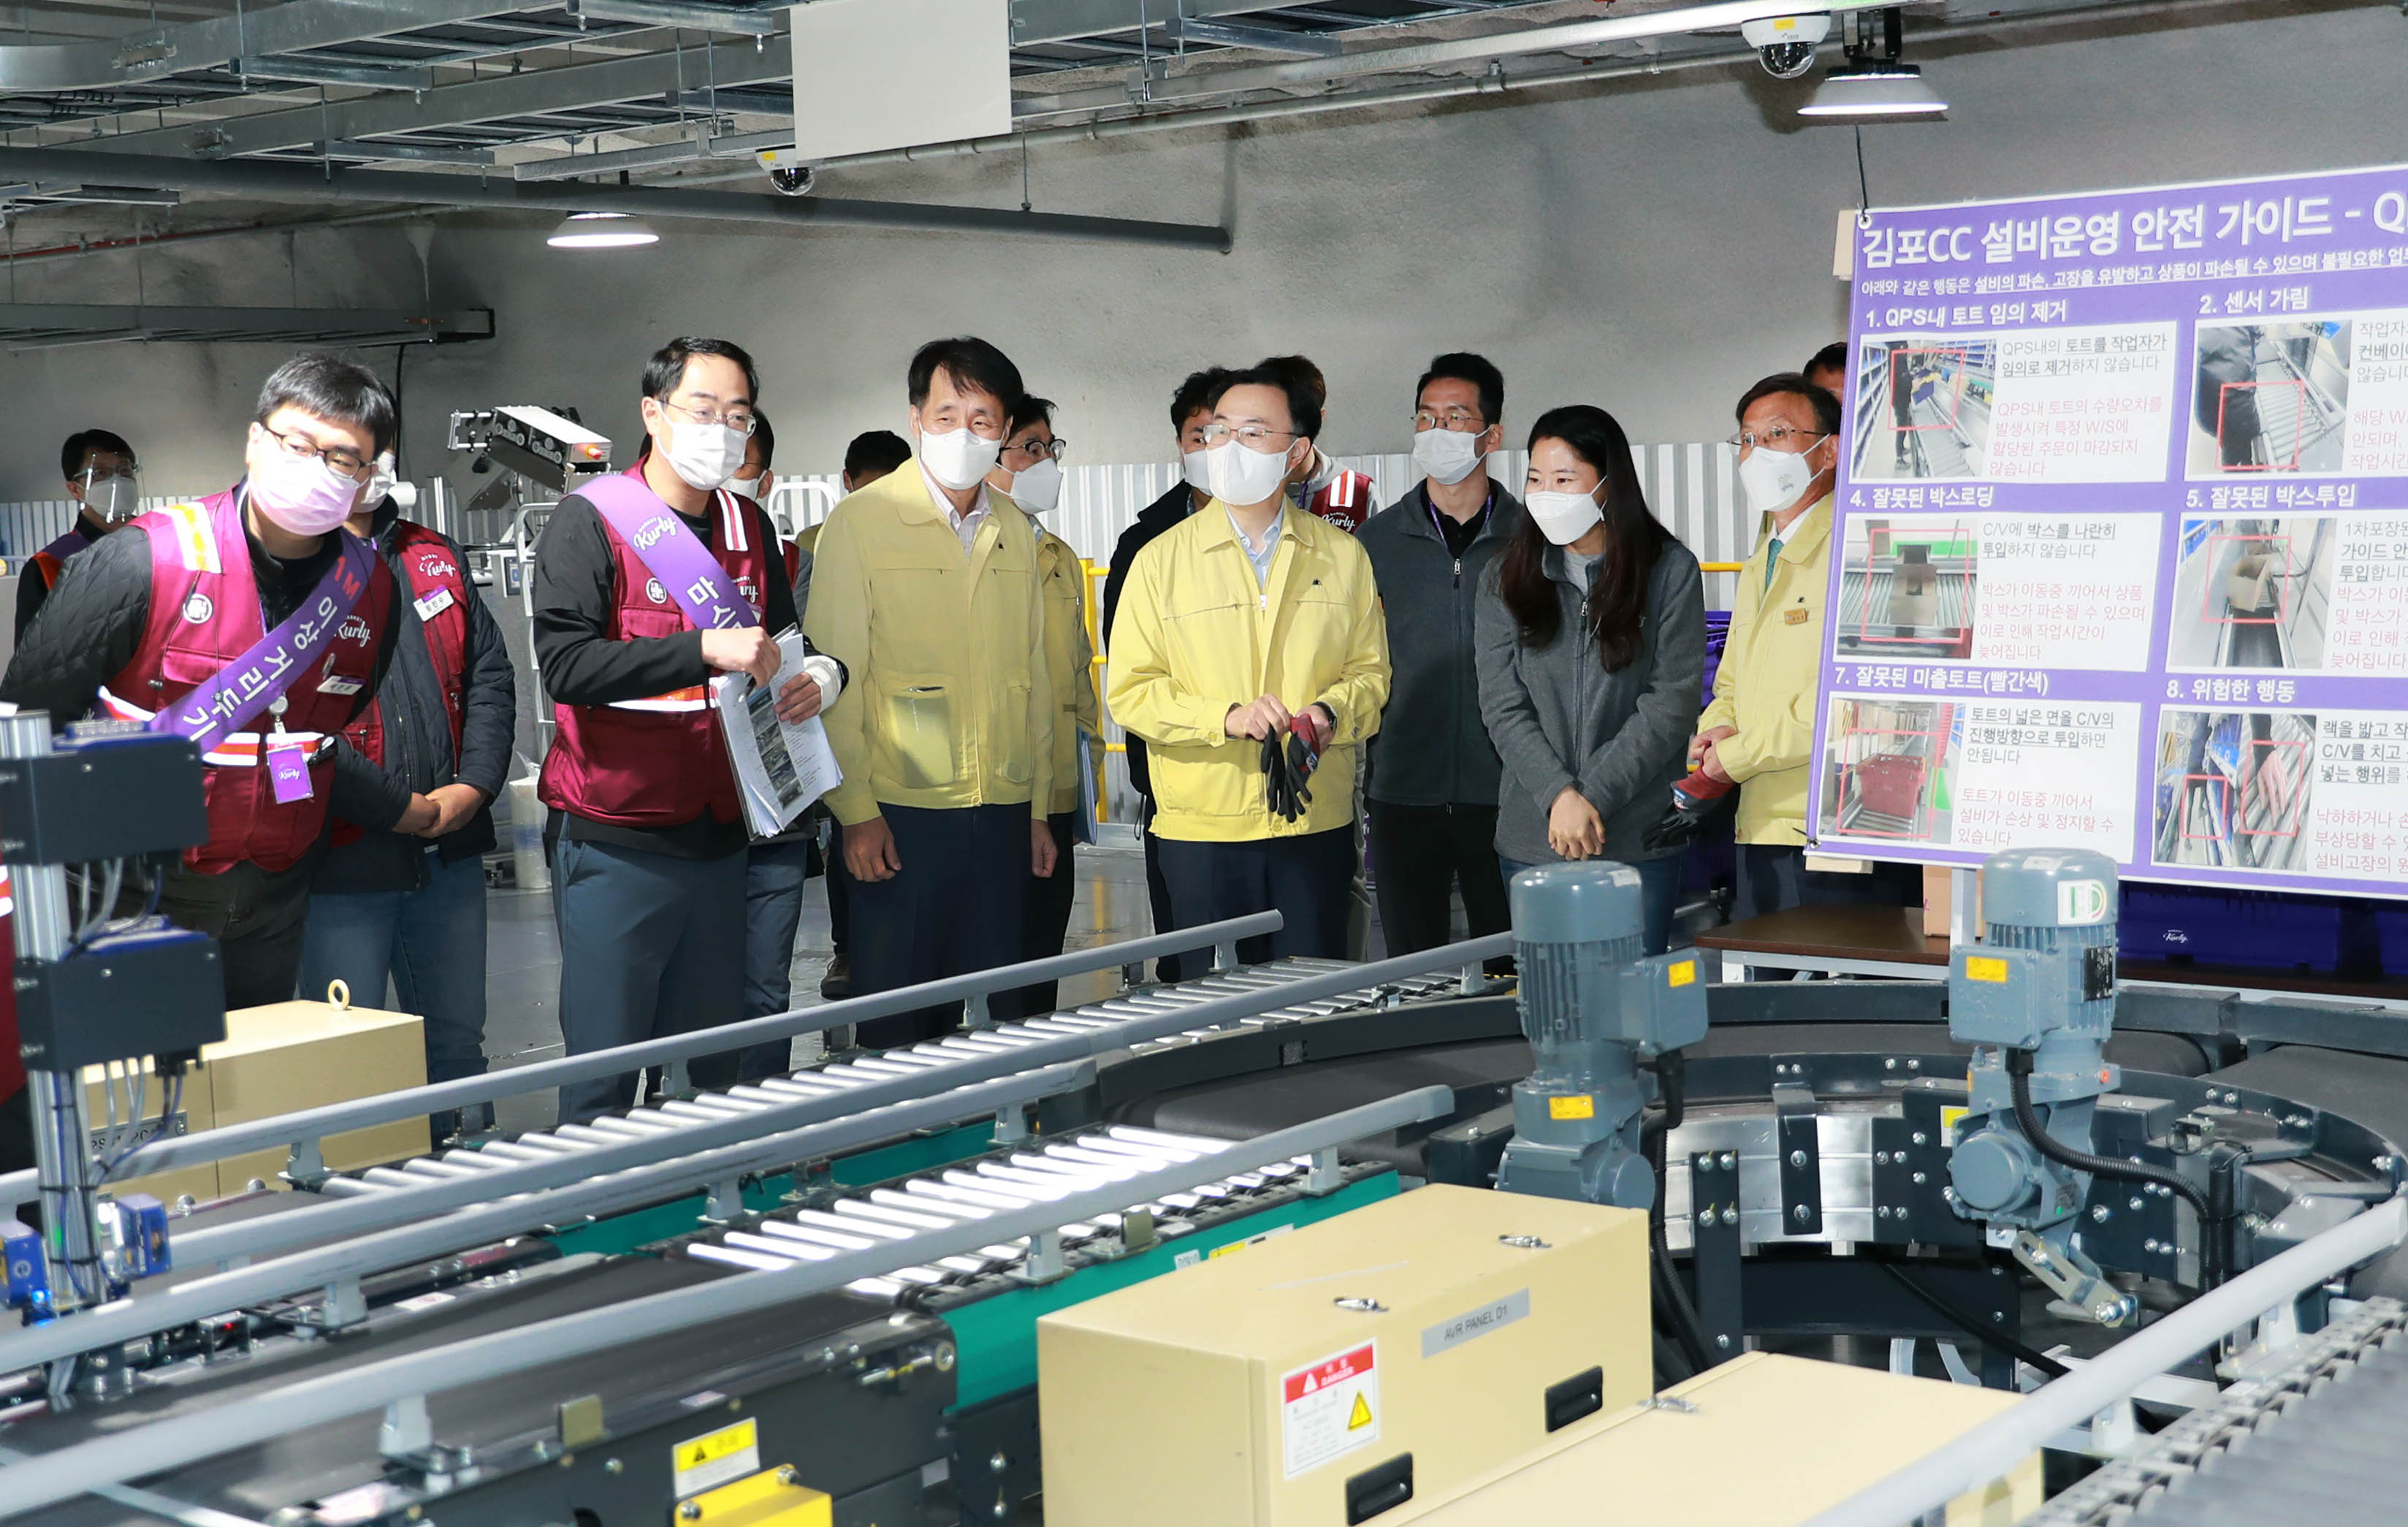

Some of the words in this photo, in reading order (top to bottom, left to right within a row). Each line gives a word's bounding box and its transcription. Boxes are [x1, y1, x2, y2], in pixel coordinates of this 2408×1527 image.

[1862, 226, 1973, 269] 김포CC
[1980, 210, 2121, 264] 설비운영
[2131, 203, 2204, 252] 안전
[2215, 196, 2333, 246] 가이드
[2373, 191, 2408, 235] Q
[1862, 278, 1899, 297] 아래와
[1902, 279, 1930, 297] 같은
[1933, 277, 1971, 296] 행동은
[1974, 273, 2016, 294] 설비의
[2052, 268, 2095, 288] 고장을
[2097, 265, 2154, 286] 유발하고
[2157, 261, 2201, 281] 상품이
[2203, 258, 2249, 278] 파손될
[2252, 256, 2268, 275] 수
[2272, 253, 2317, 274] 있으며
[2321, 248, 2384, 270] 불필요한
[2199, 294, 2217, 314] 2.
[2225, 288, 2263, 314] 센서
[2268, 286, 2309, 311] 가림
[1865, 309, 1881, 327] 1.
[1885, 305, 1946, 328] QPS내
[1951, 305, 1985, 326] 토트
[1989, 301, 2025, 326] 임의
[2030, 299, 2067, 322] 제거
[2359, 320, 2408, 339] 작업자
[2002, 338, 2061, 357] QPS내의
[2065, 336, 2106, 354] 토트를
[2111, 333, 2167, 352] 작업자가
[2358, 341, 2408, 362] 컨베이
[2001, 359, 2041, 378] 임의로
[2045, 357, 2099, 376] 제거하지
[2103, 354, 2159, 373] 않습니다
[1997, 400, 2044, 416] QPS내
[2048, 398, 2088, 416] 토트의
[2054, 419, 2081, 437] 특정
[2086, 417, 2129, 435] W/S에
[2352, 409, 2384, 427] 해당
[1992, 441, 2035, 457] 할당된
[2039, 439, 2079, 457] 주문이
[2083, 438, 2139, 456] 마감되지
[1989, 460, 2046, 478] 않습니다
[1848, 489, 1867, 508] 4.
[1872, 486, 1924, 509] 잘못된
[1929, 485, 1994, 508] 박스로딩
[2185, 488, 2204, 509] 5.
[2210, 485, 2270, 509] 잘못된
[2274, 482, 2356, 508] 박스투입
[633, 516, 677, 551] Kurly
[1982, 521, 2023, 537] C/V에
[2027, 522, 2070, 539] 박스를
[2074, 522, 2116, 540] 나란히
[1982, 541, 2035, 559] 투입하지
[2039, 542, 2097, 560] 않습니다
[2341, 541, 2388, 561] 가이드
[1981, 582, 2018, 598] 박스가
[2021, 582, 2063, 599] 이동중
[2067, 584, 2111, 601] 끼어서
[2115, 584, 2144, 602] 상품
[2337, 585, 2384, 603] 박스가
[1981, 603, 1994, 619] 및
[1997, 603, 2033, 620] 박스가
[2083, 605, 2098, 620] 수
[2103, 605, 2146, 622] 있으며
[2335, 608, 2350, 625] 및
[2355, 608, 2402, 625] 박스가
[1979, 623, 2005, 639] 이로
[2008, 623, 2033, 639] 인해
[2035, 623, 2106, 641] 작업시간이
[2332, 629, 2363, 647] 이로
[2368, 629, 2399, 648] 인해
[1978, 643, 2042, 660] 늦어집니다
[2330, 651, 2407, 671] 늦어집니다
[1834, 666, 1851, 685] 7.
[1856, 666, 1908, 688] 잘못된
[2165, 679, 2185, 698] 8.
[2191, 677, 2251, 702] 위험한
[2256, 678, 2295, 704] 행동
[1970, 707, 2012, 724] 토트의
[2016, 708, 2043, 726] 넓은
[2046, 709, 2073, 727] 면을
[2076, 711, 2114, 729] C/V의
[1968, 726, 2050, 746] 진행방향으로
[2053, 730, 2107, 749] 투입하면
[1966, 747, 2022, 765] 안됩니다
[2322, 743, 2366, 761] C/V를
[2370, 743, 2401, 762] 치고
[2355, 765, 2401, 784] 행위를
[1961, 787, 2004, 806] 토트가
[2007, 789, 2048, 808] 이동중
[2051, 792, 2094, 810] 끼어서
[1959, 807, 2000, 825] 설비가
[2005, 810, 2033, 828] 손상
[2036, 812, 2050, 830] 및
[2054, 813, 2096, 832] 정지할
[2101, 816, 2114, 834] 수
[1957, 827, 2011, 846] 있습니다
[2314, 830, 2377, 850] 부상당할
[2382, 834, 2397, 852] 수
[2314, 853, 2391, 874] 설비고장의
[1464, 1310, 1495, 1331] PANEL
